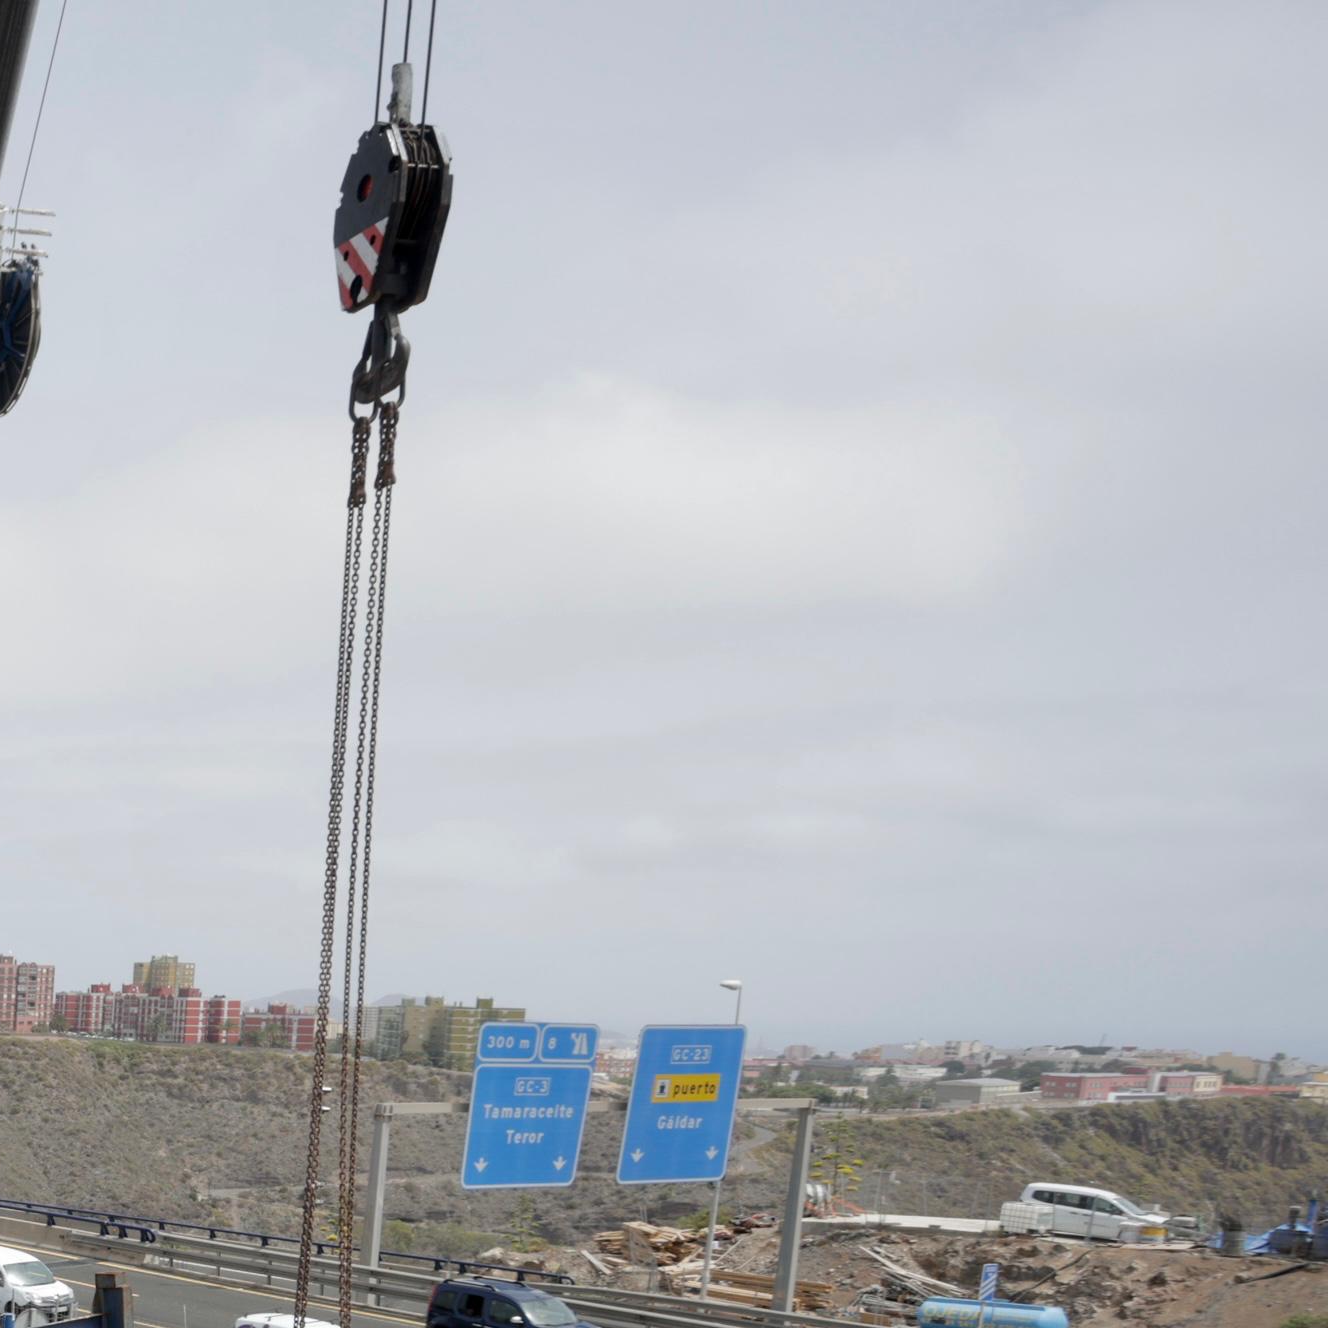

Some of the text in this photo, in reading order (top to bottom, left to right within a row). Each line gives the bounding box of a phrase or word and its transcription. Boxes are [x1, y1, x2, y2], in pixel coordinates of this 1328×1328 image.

[487, 1036, 530, 1049] 300 m
[548, 1037, 557, 1050] 8
[516, 1080, 549, 1093] GC-3
[672, 1081, 716, 1099] puerto
[483, 1104, 574, 1119] Tamaraceite
[657, 1115, 703, 1129] Gáldar
[506, 1129, 544, 1144] Teror
